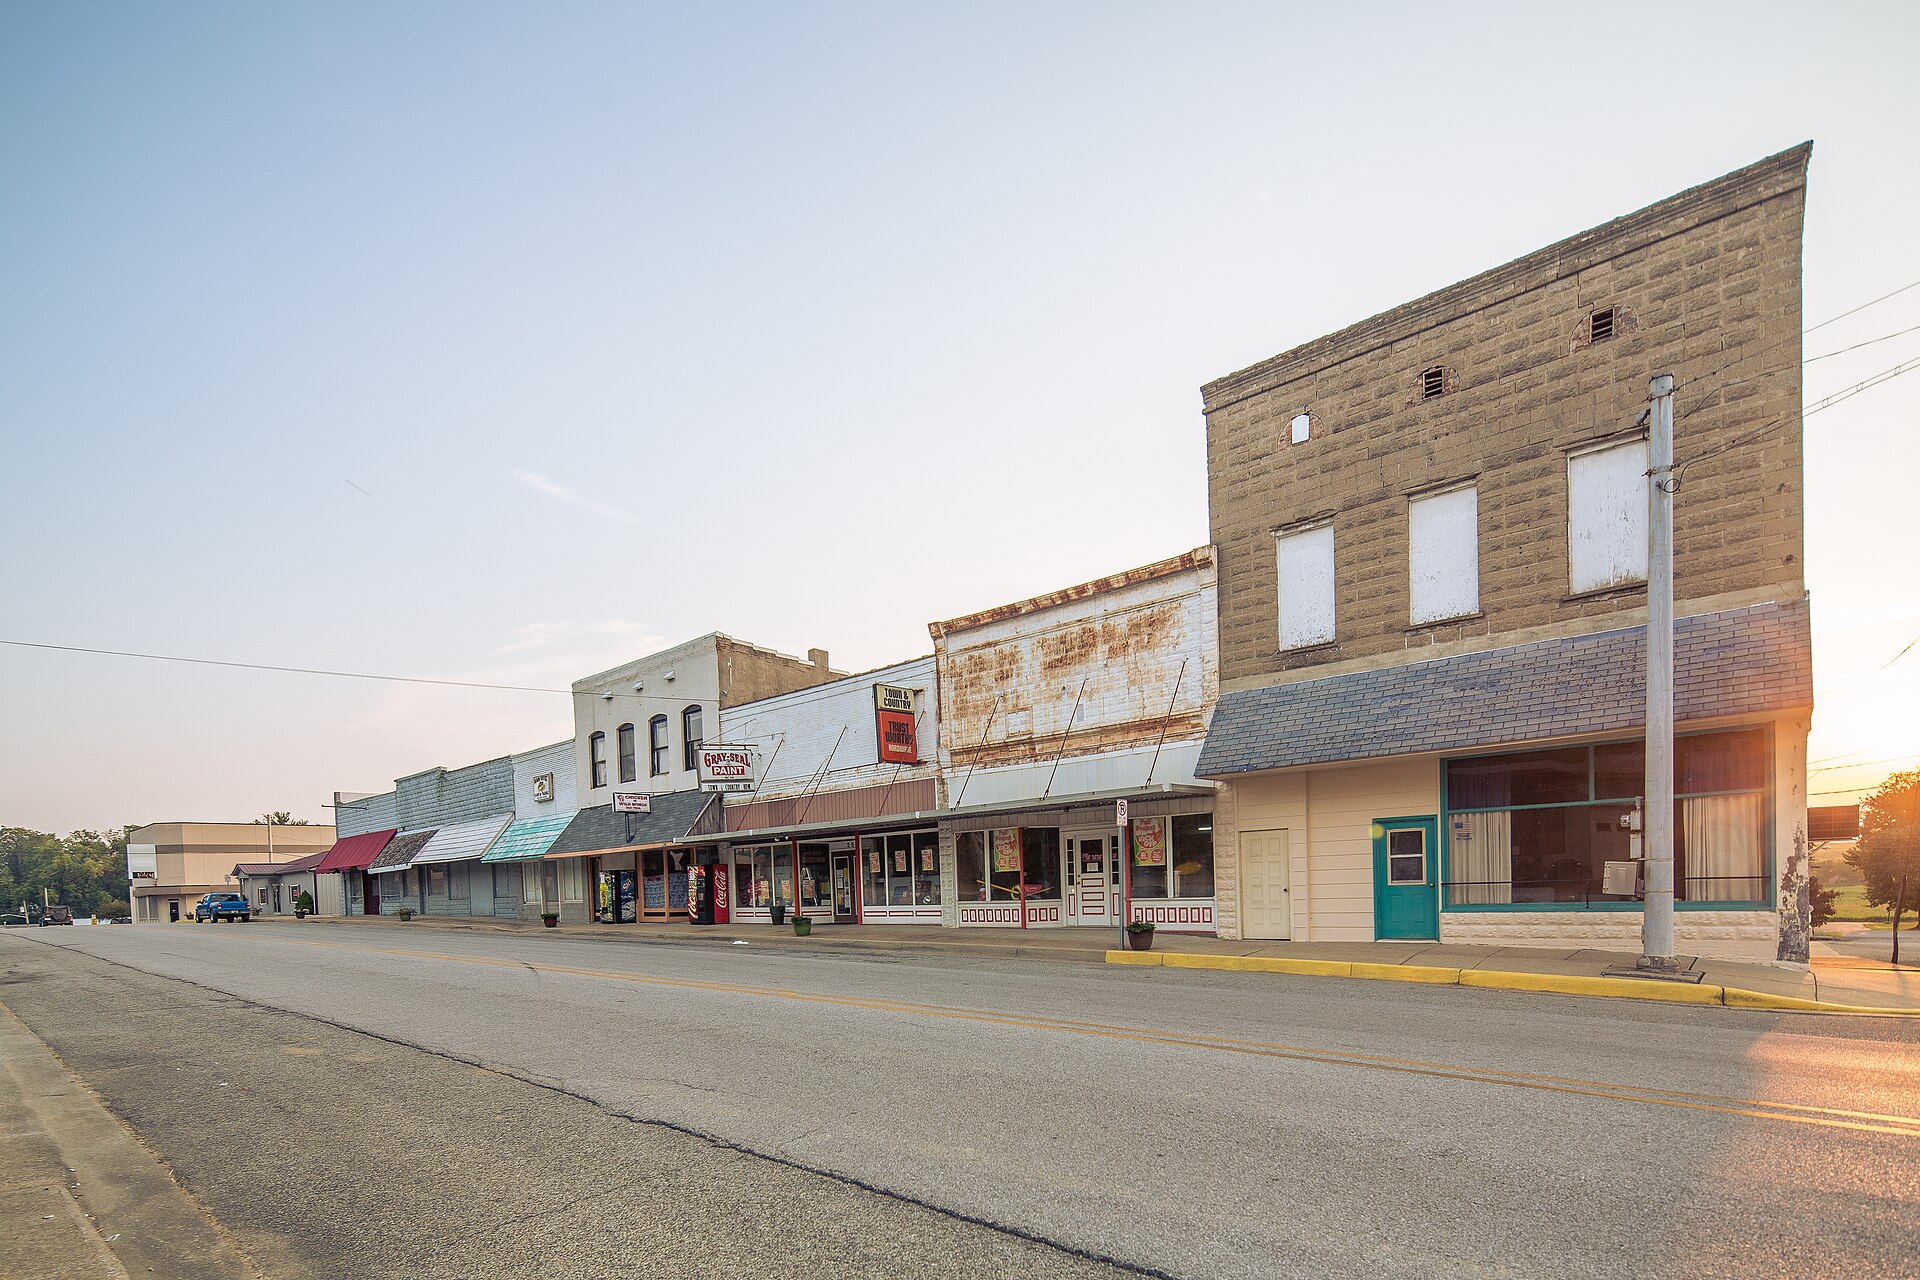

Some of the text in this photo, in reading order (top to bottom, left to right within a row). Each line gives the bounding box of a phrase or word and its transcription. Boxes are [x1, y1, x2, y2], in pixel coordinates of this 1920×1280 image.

[884, 688, 902, 699] TOWN
[884, 697, 911, 710] COUNTRY
[888, 721, 909, 734] TRUST
[885, 732, 913, 744] WORTHY
[704, 752, 751, 768] GRAY-SEAL
[713, 766, 744, 775] PAINT
[715, 869, 727, 908] Coca-Cola
